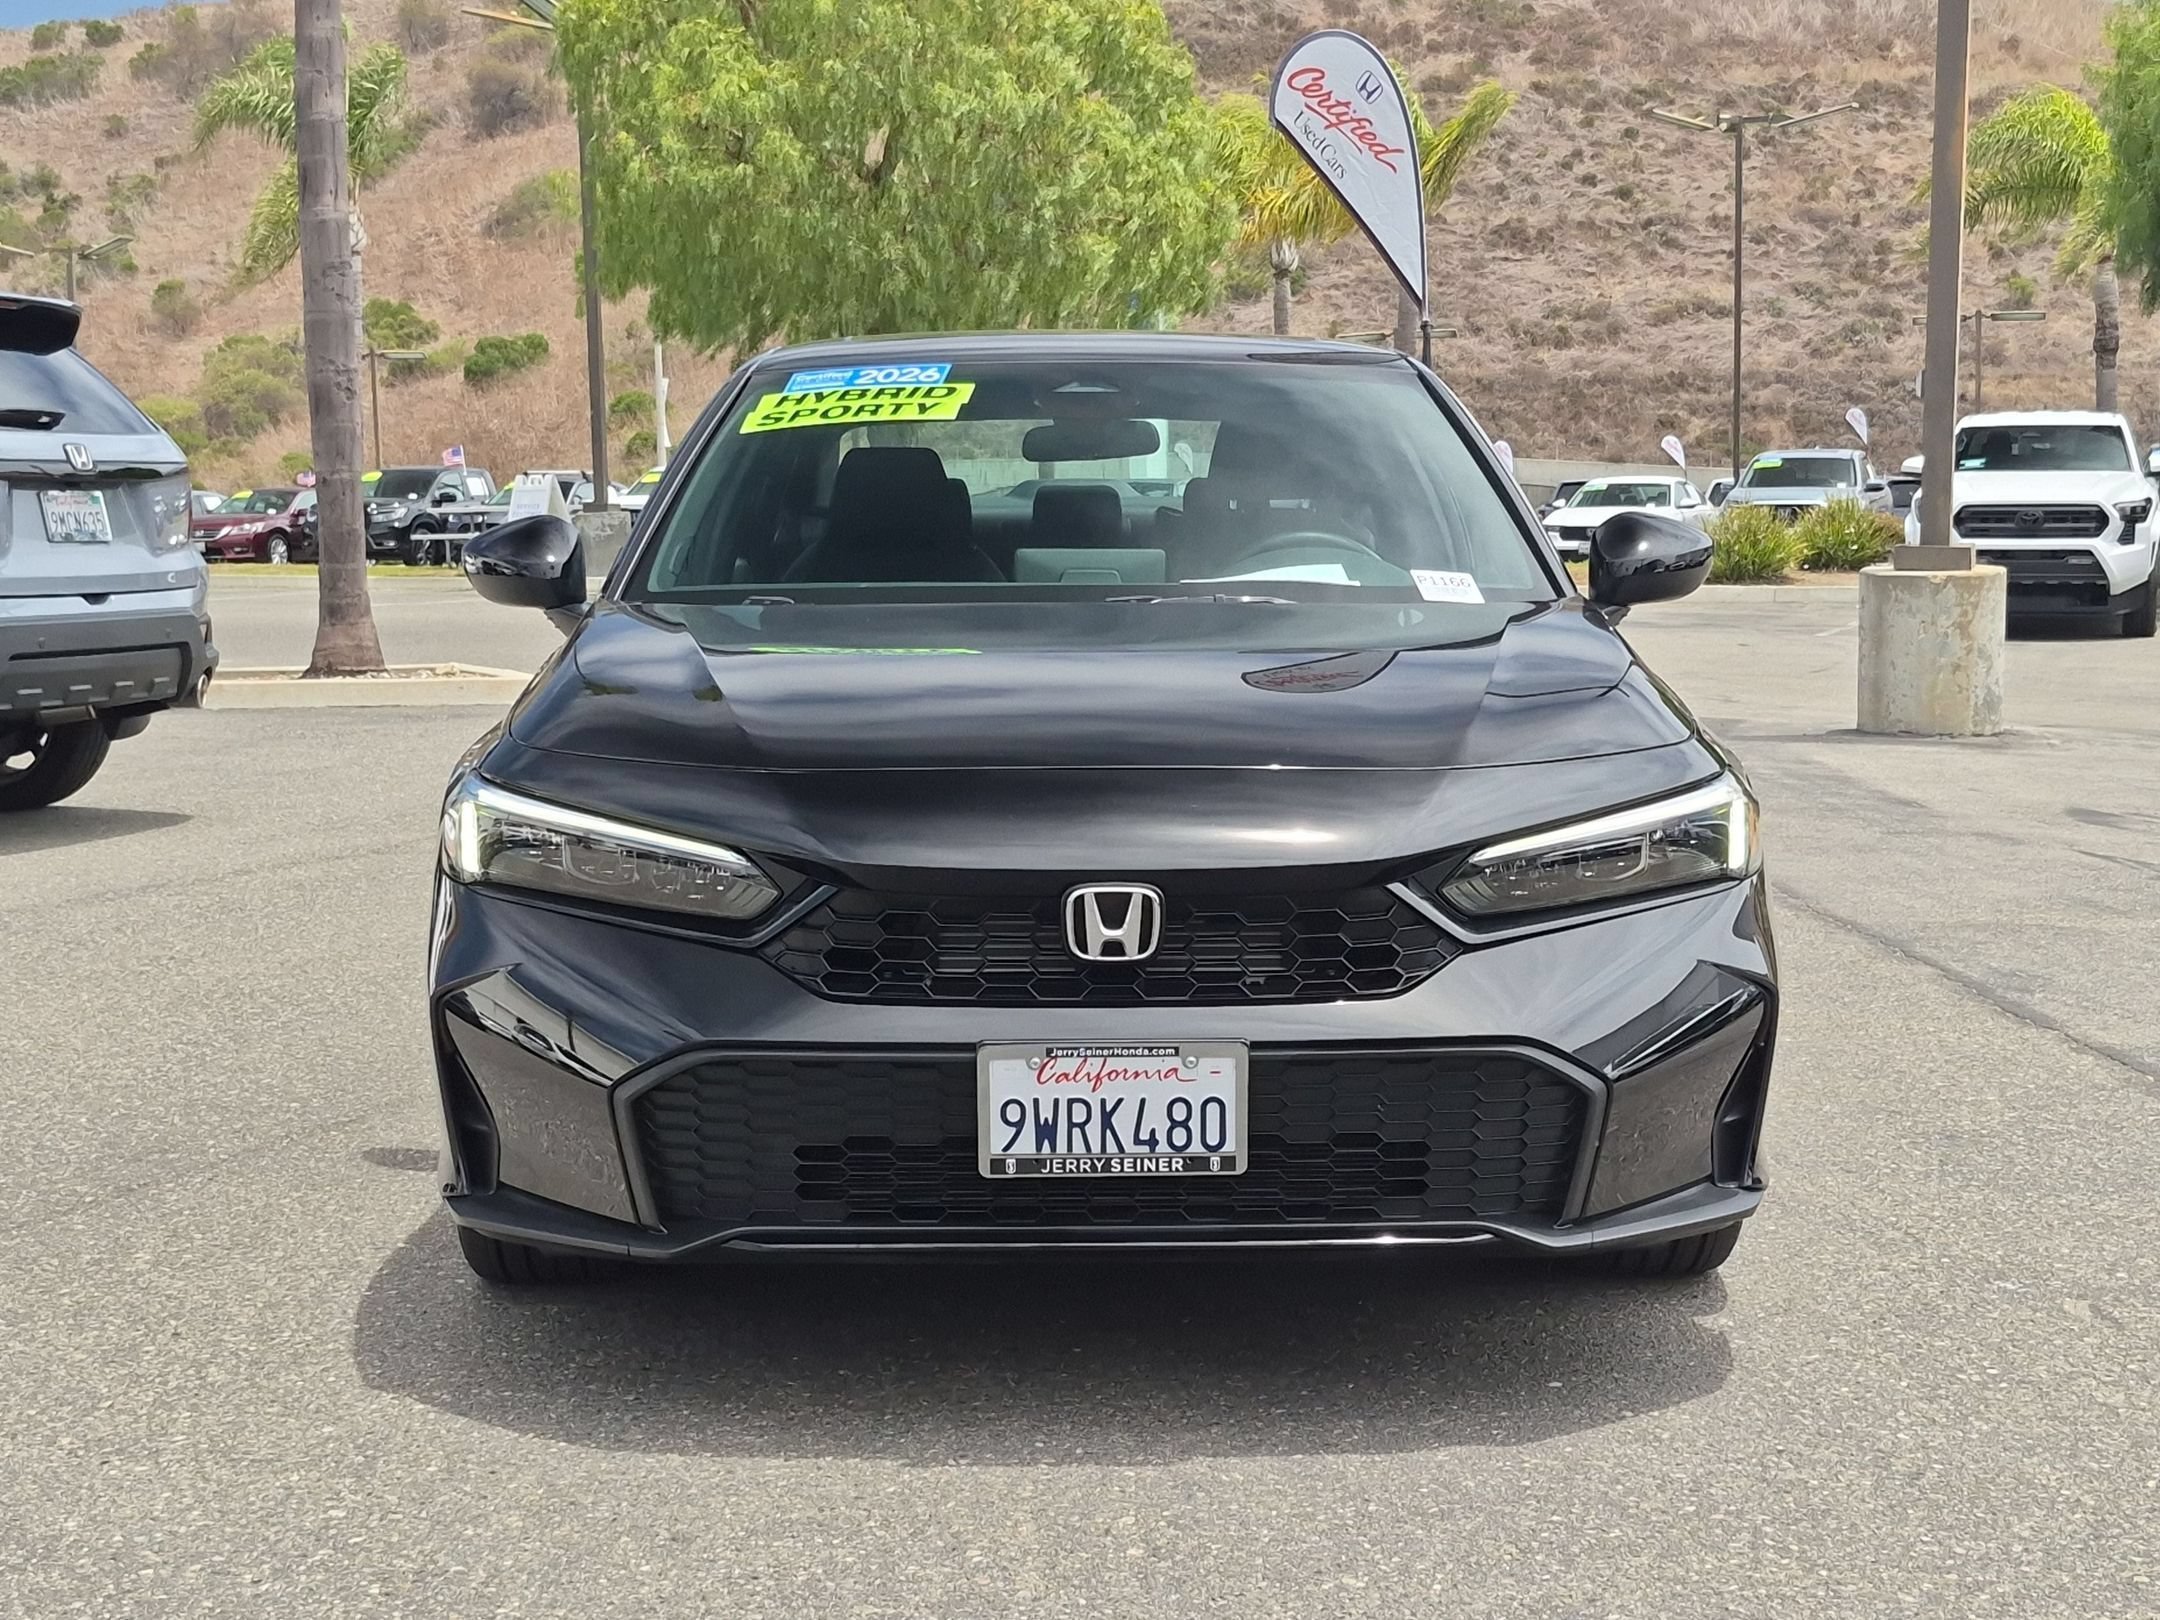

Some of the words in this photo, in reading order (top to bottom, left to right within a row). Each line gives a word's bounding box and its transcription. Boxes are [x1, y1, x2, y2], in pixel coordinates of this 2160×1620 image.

[1287, 67, 1404, 174] Certified
[1293, 110, 1326, 151] Used
[1320, 143, 1347, 180] Cars
[855, 367, 941, 384] 2026
[773, 386, 958, 409] HYBRID
[756, 402, 941, 426] SPORTY
[1050, 1047, 1176, 1057] JerrySeinerHonda.com
[1036, 1057, 1198, 1093] California
[1000, 1096, 1228, 1154] 9WRK480
[1041, 1158, 1107, 1173] JERRY
[1110, 1157, 1184, 1172] SEINER
